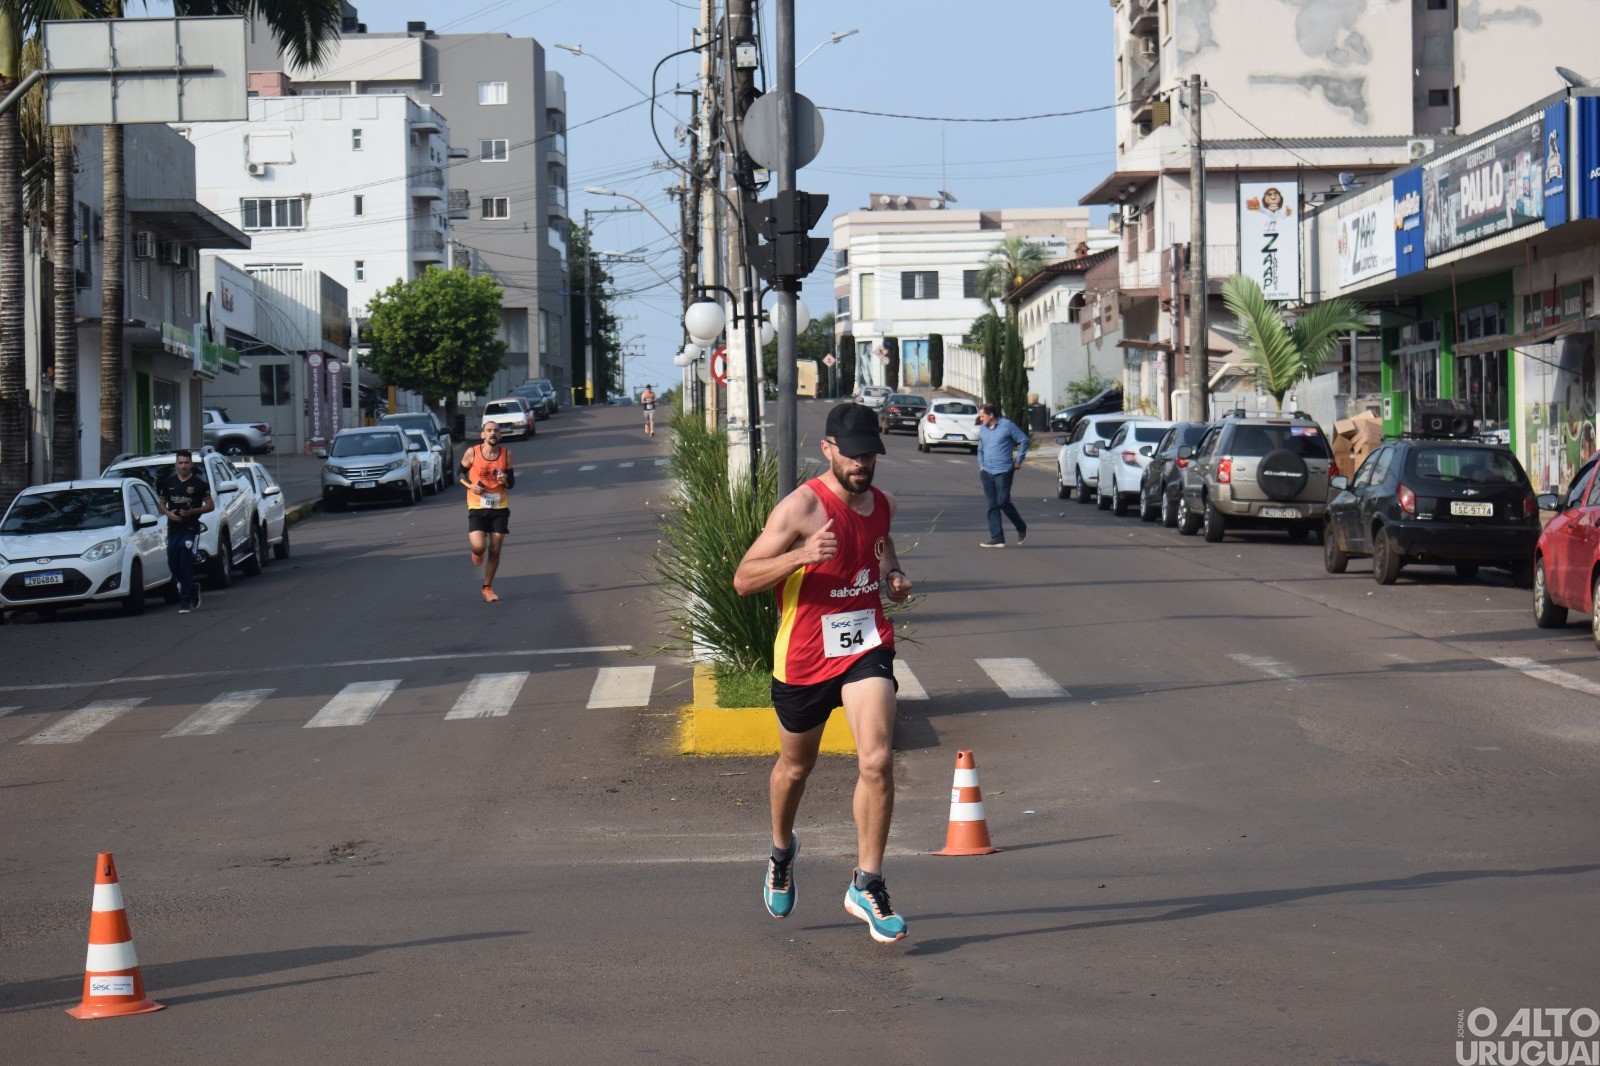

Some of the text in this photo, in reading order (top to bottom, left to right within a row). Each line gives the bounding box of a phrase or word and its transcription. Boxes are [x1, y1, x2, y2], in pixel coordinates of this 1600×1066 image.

[1460, 160, 1504, 220] PAULO
[1261, 232, 1279, 291] ZAAP
[1351, 211, 1377, 276] ZAAP
[312, 368, 320, 437] ESTACIONAMENTO
[840, 629, 865, 648] 54
